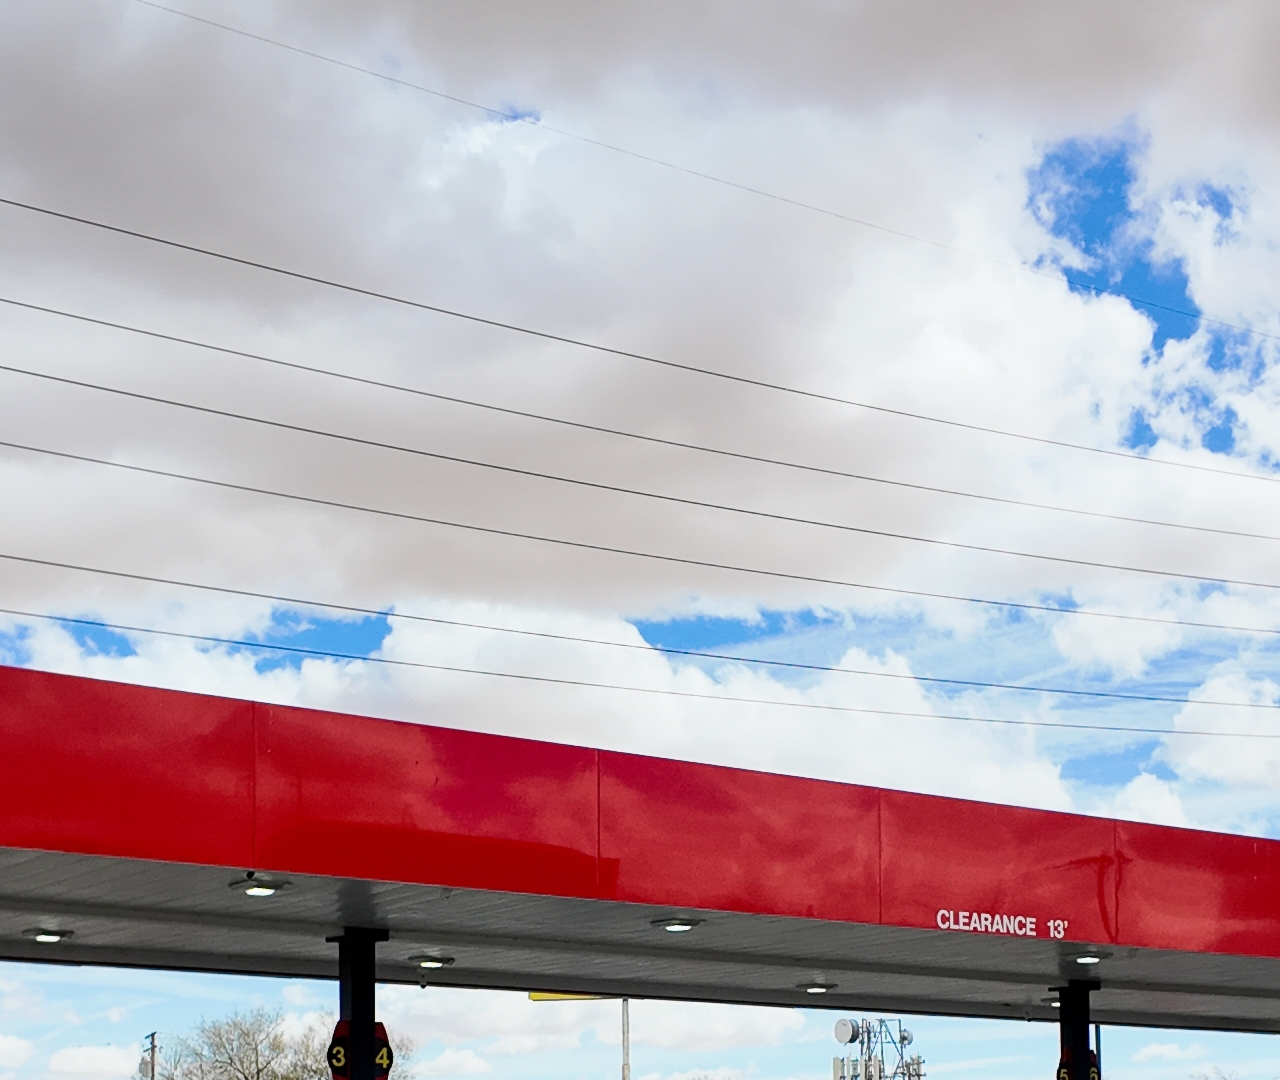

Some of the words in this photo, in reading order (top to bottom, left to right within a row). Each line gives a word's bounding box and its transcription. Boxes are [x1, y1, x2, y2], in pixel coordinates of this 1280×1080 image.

[936, 909, 1037, 936] CLEARANCE
[1047, 919, 1069, 939] 13'
[331, 1046, 346, 1067] 3
[375, 1047, 390, 1069] 4
